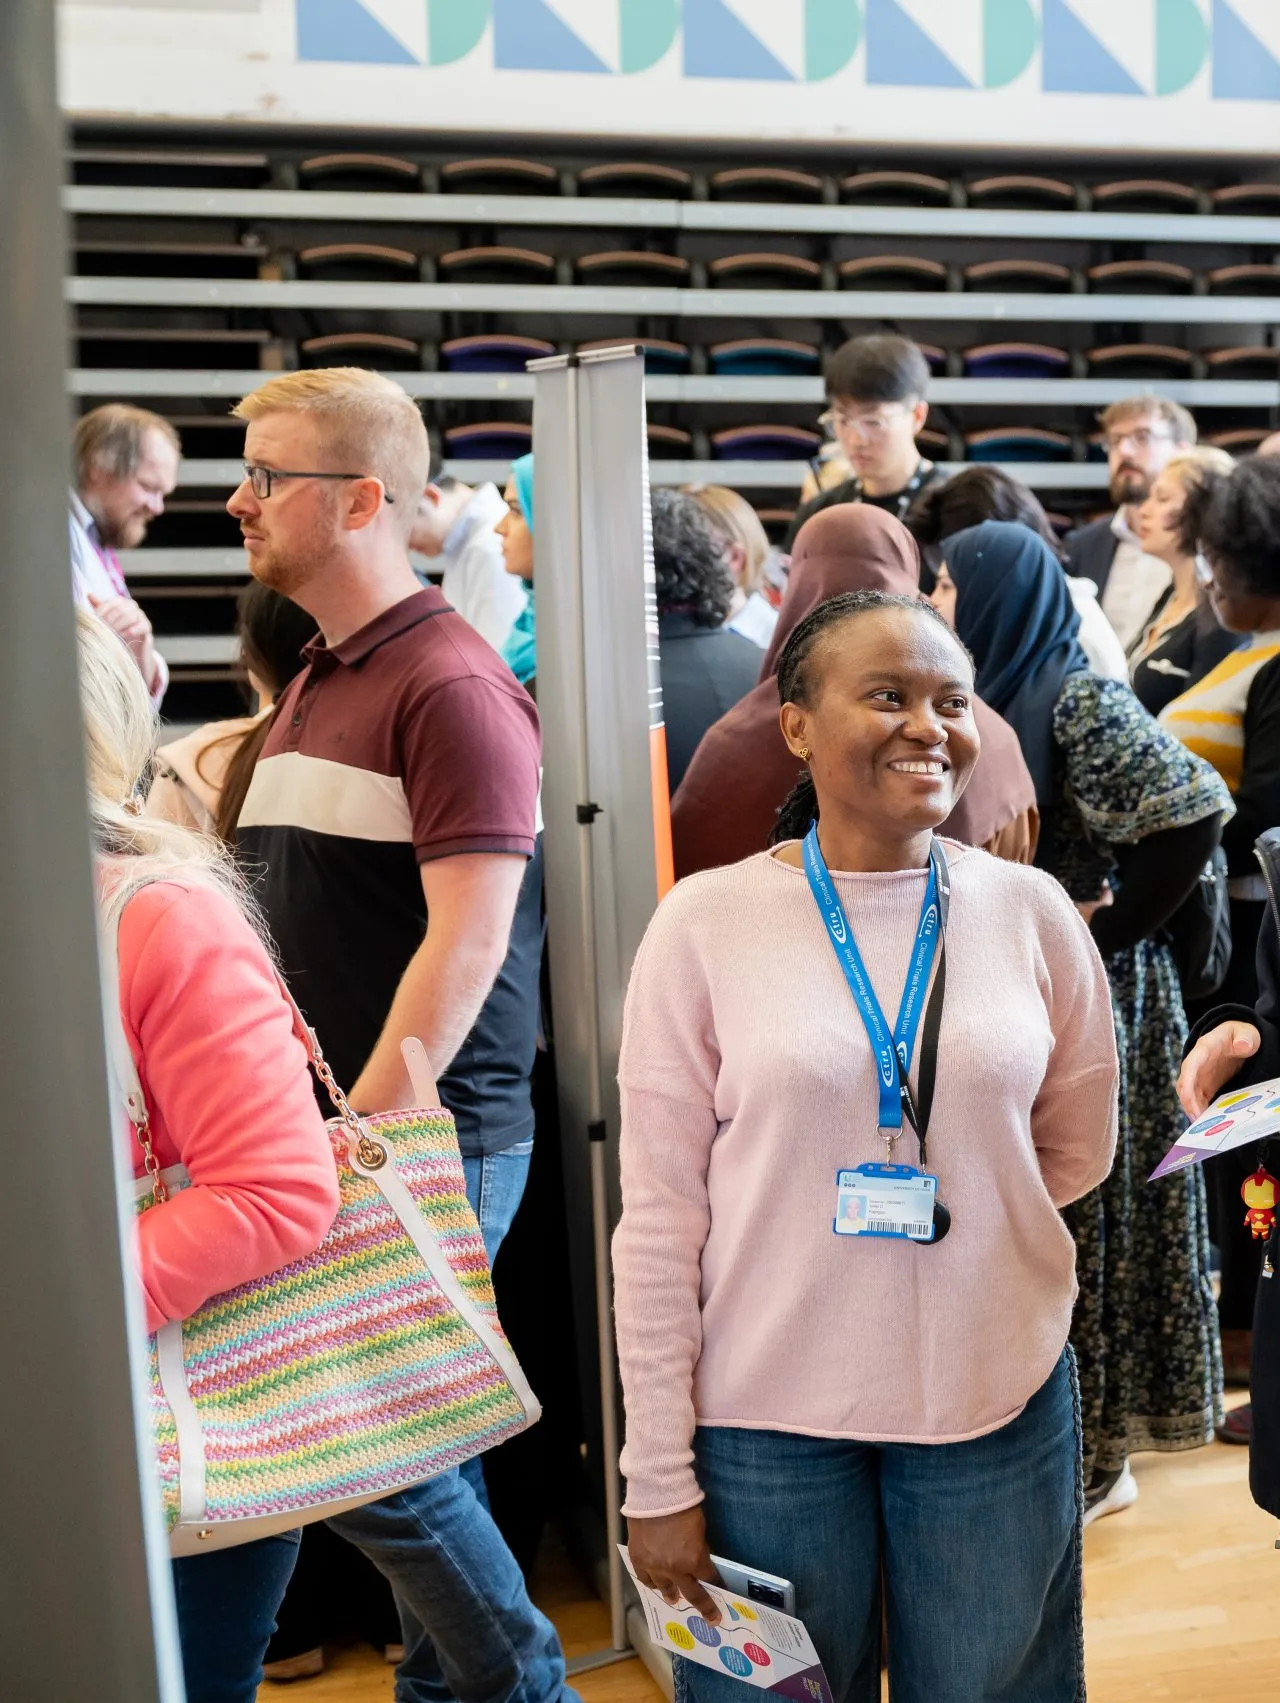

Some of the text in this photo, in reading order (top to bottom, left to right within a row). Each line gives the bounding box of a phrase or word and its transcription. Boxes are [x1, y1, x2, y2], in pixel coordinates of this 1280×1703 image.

[819, 881, 832, 905] Clinical
[829, 912, 842, 935] ctru
[925, 912, 935, 935] ctru
[844, 948, 885, 1042] Clinical Trials Research Unit
[901, 942, 928, 1035] Clinical Trials Research Unit
[881, 1050, 891, 1077] ctru
